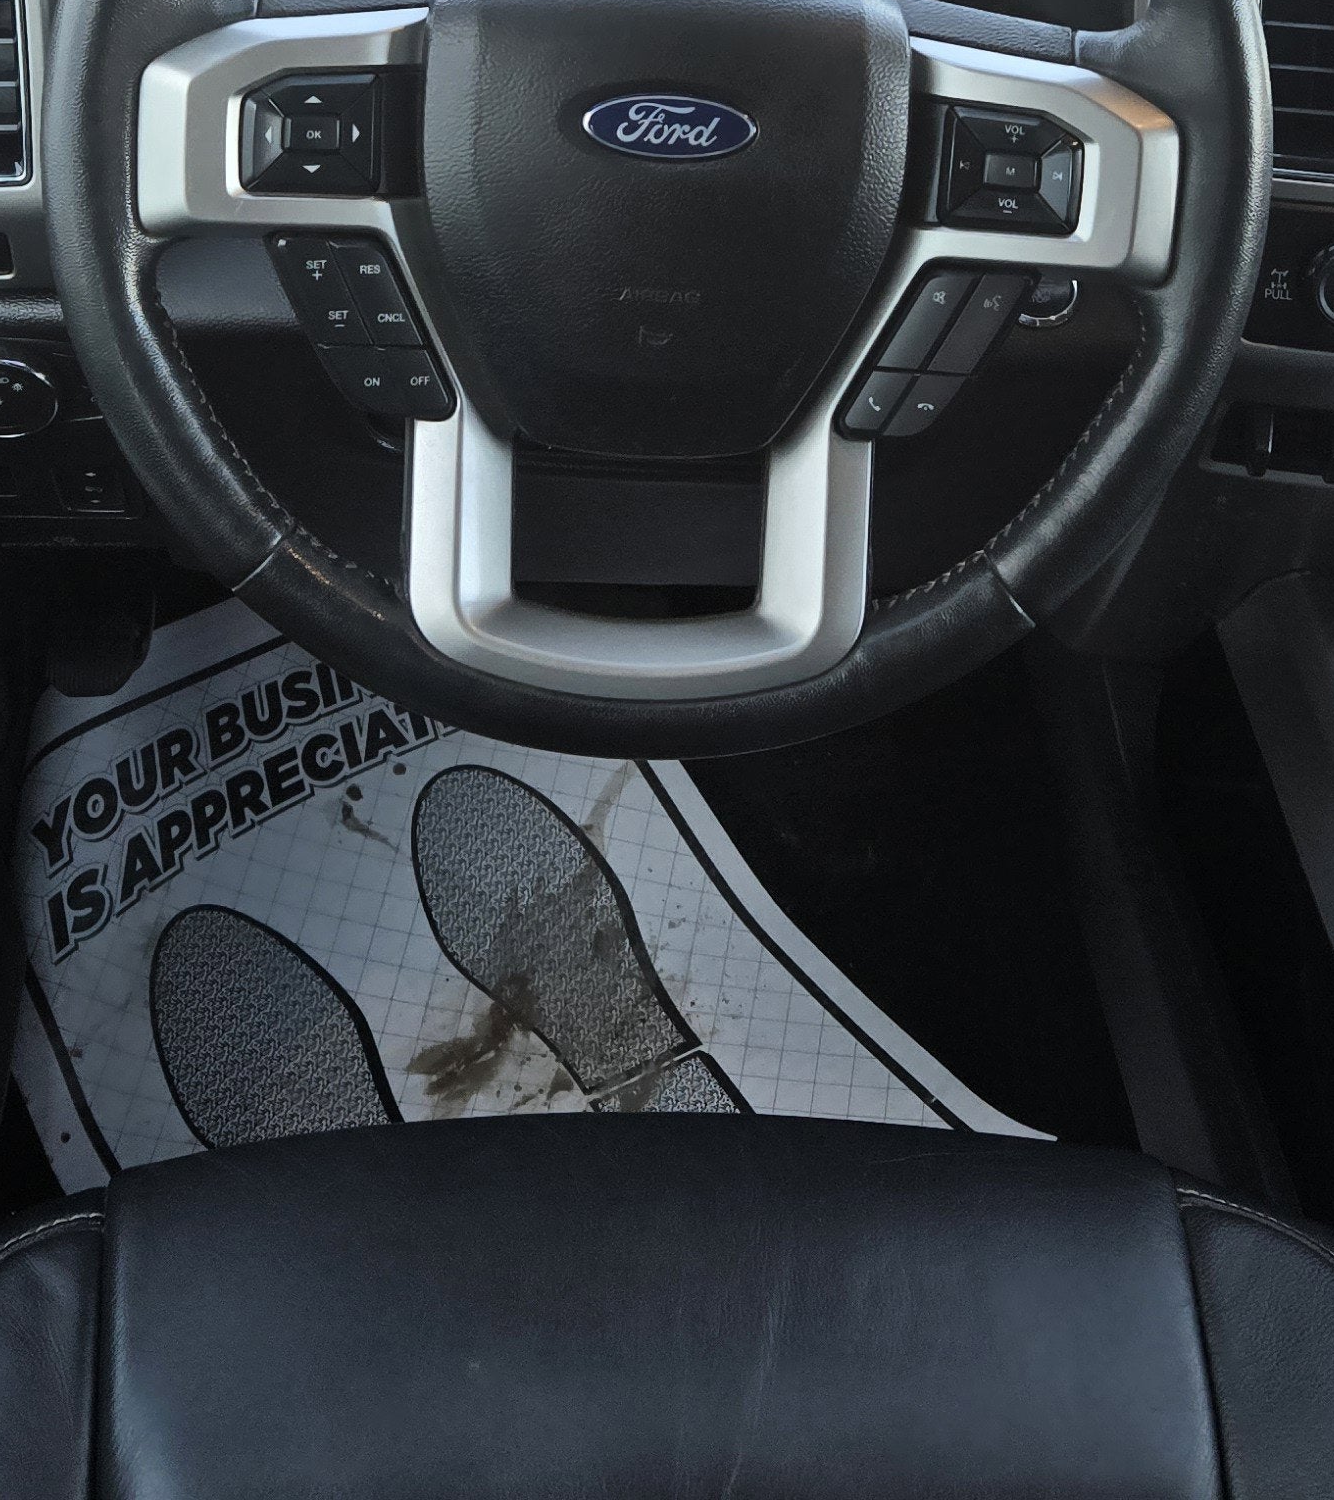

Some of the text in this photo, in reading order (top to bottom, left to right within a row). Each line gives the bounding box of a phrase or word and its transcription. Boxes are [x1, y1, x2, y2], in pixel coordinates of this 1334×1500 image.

[616, 102, 721, 147] Ford
[1004, 124, 1025, 136] VOL
[306, 130, 322, 139] OK
[1005, 166, 1016, 176] M
[998, 197, 1019, 209] VOL
[305, 259, 328, 270] SET
[359, 264, 381, 275] RES
[1263, 288, 1294, 301] PULL
[327, 309, 349, 321] SET
[377, 313, 406, 323] CNCL
[363, 377, 381, 387] ON
[410, 375, 430, 386] OFF
[32, 728, 197, 867] YOUR
[47, 706, 431, 954] IS APPRECIAT
